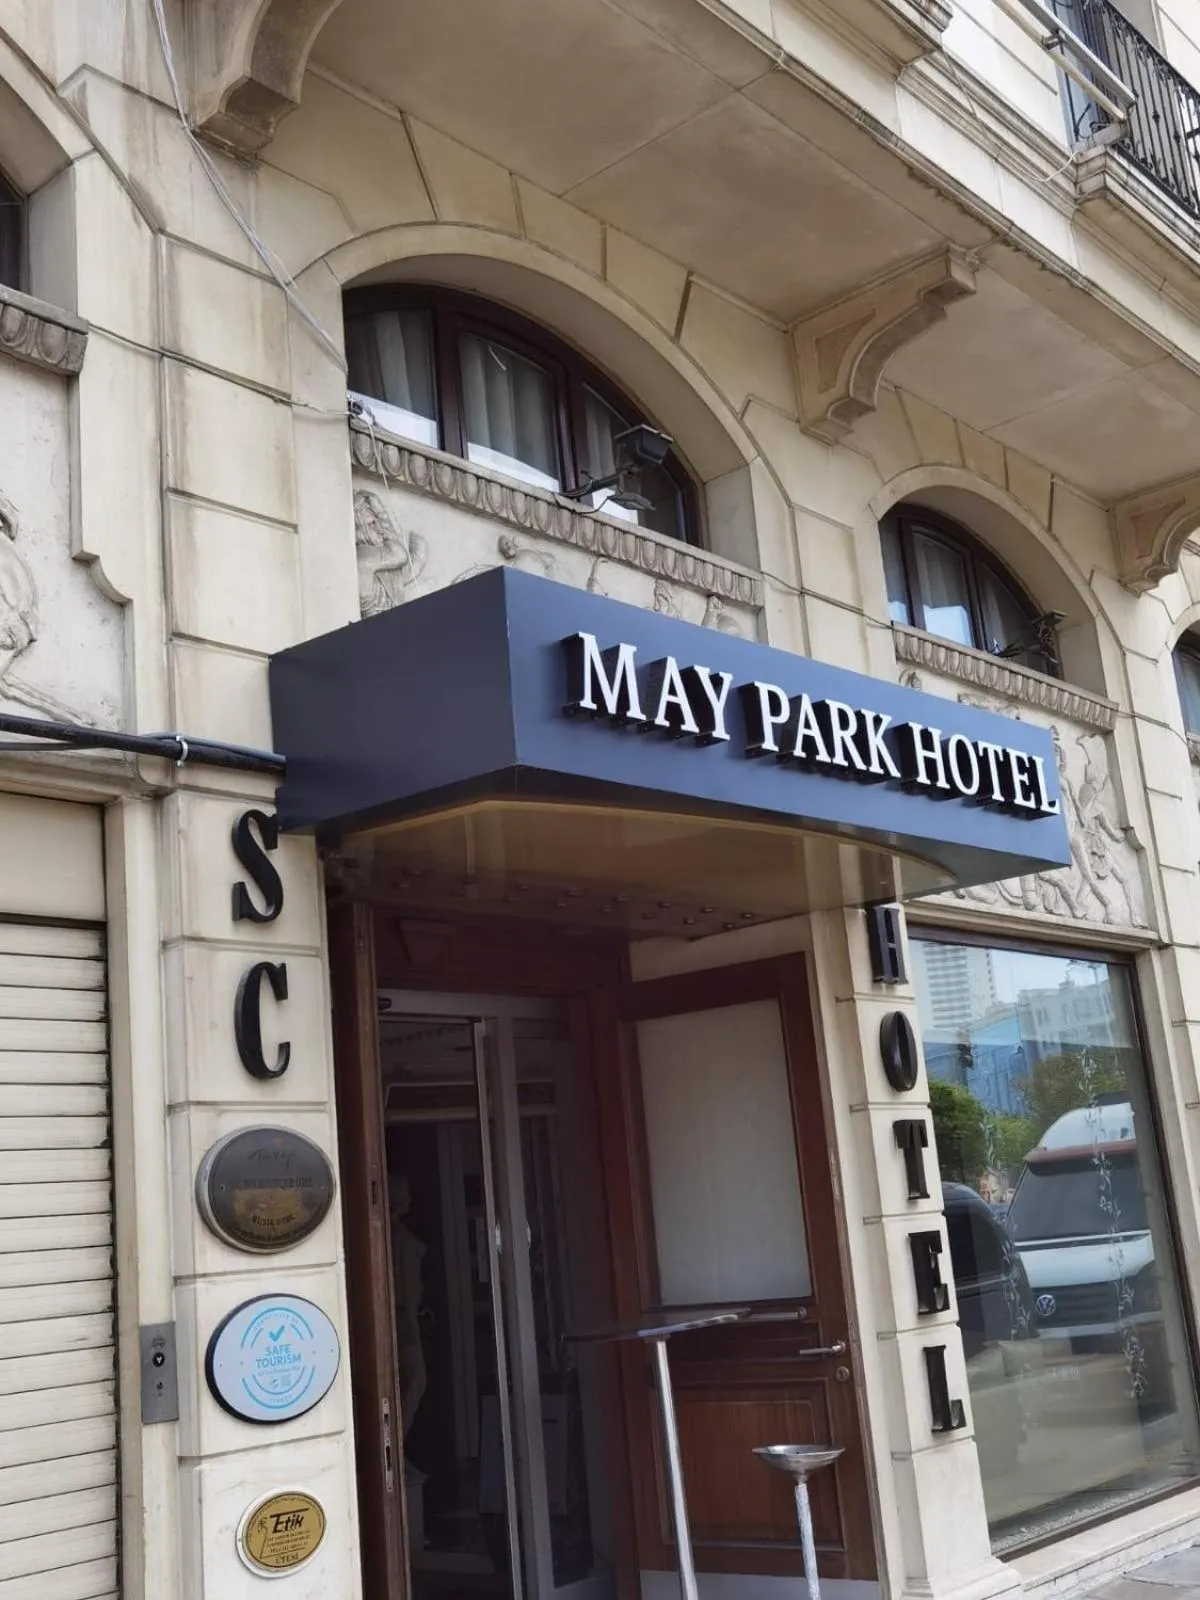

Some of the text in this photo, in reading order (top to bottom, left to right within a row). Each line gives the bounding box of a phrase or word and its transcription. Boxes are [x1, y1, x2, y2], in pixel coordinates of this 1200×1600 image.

[576, 631, 1061, 816] MAY PARK HOTEL
[866, 904, 968, 1434] HOTEL
[255, 1352, 302, 1370] TOURISM
[264, 1343, 291, 1356] SAFE
